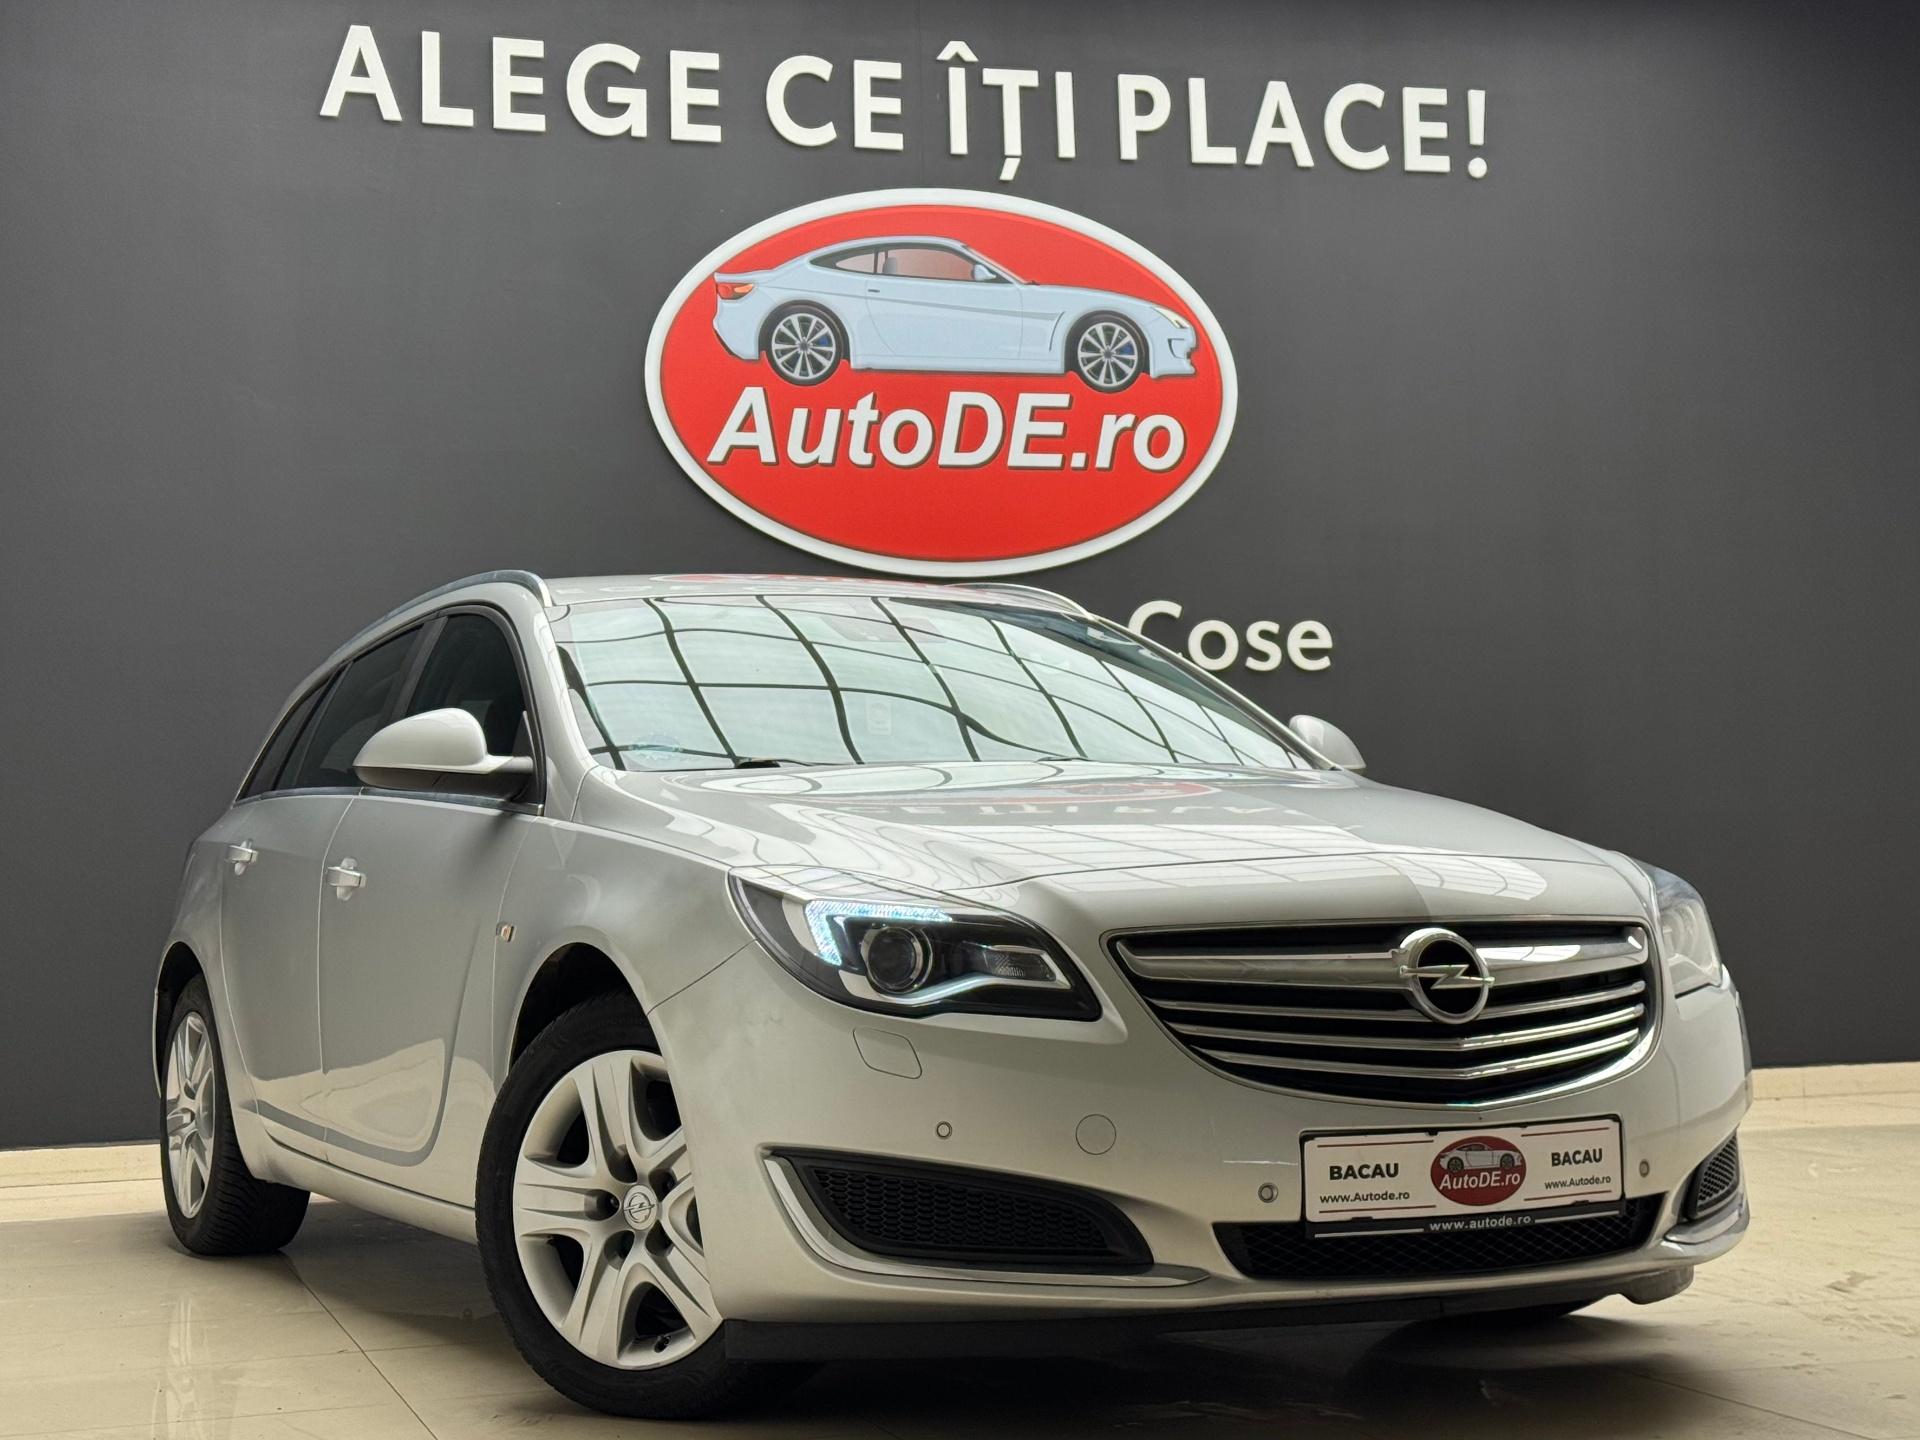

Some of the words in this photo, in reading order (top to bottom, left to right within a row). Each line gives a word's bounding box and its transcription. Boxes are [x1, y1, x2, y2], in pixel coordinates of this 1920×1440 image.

[319, 24, 722, 143] ALEGE
[766, 54, 904, 151] CE
[936, 40, 1076, 181] ÎȚI
[1117, 73, 1488, 179] PLACE!
[706, 386, 1186, 471] AutoDE.ro
[1550, 1148, 1603, 1168] BACAU
[1328, 1162, 1400, 1181] BACAU
[1438, 1170, 1521, 1191] AutoDE.ro
[1544, 1173, 1612, 1191] www.Autode.ro
[1319, 1189, 1411, 1205] www.Autode.ro
[1429, 1214, 1532, 1232] www.autode.ro
